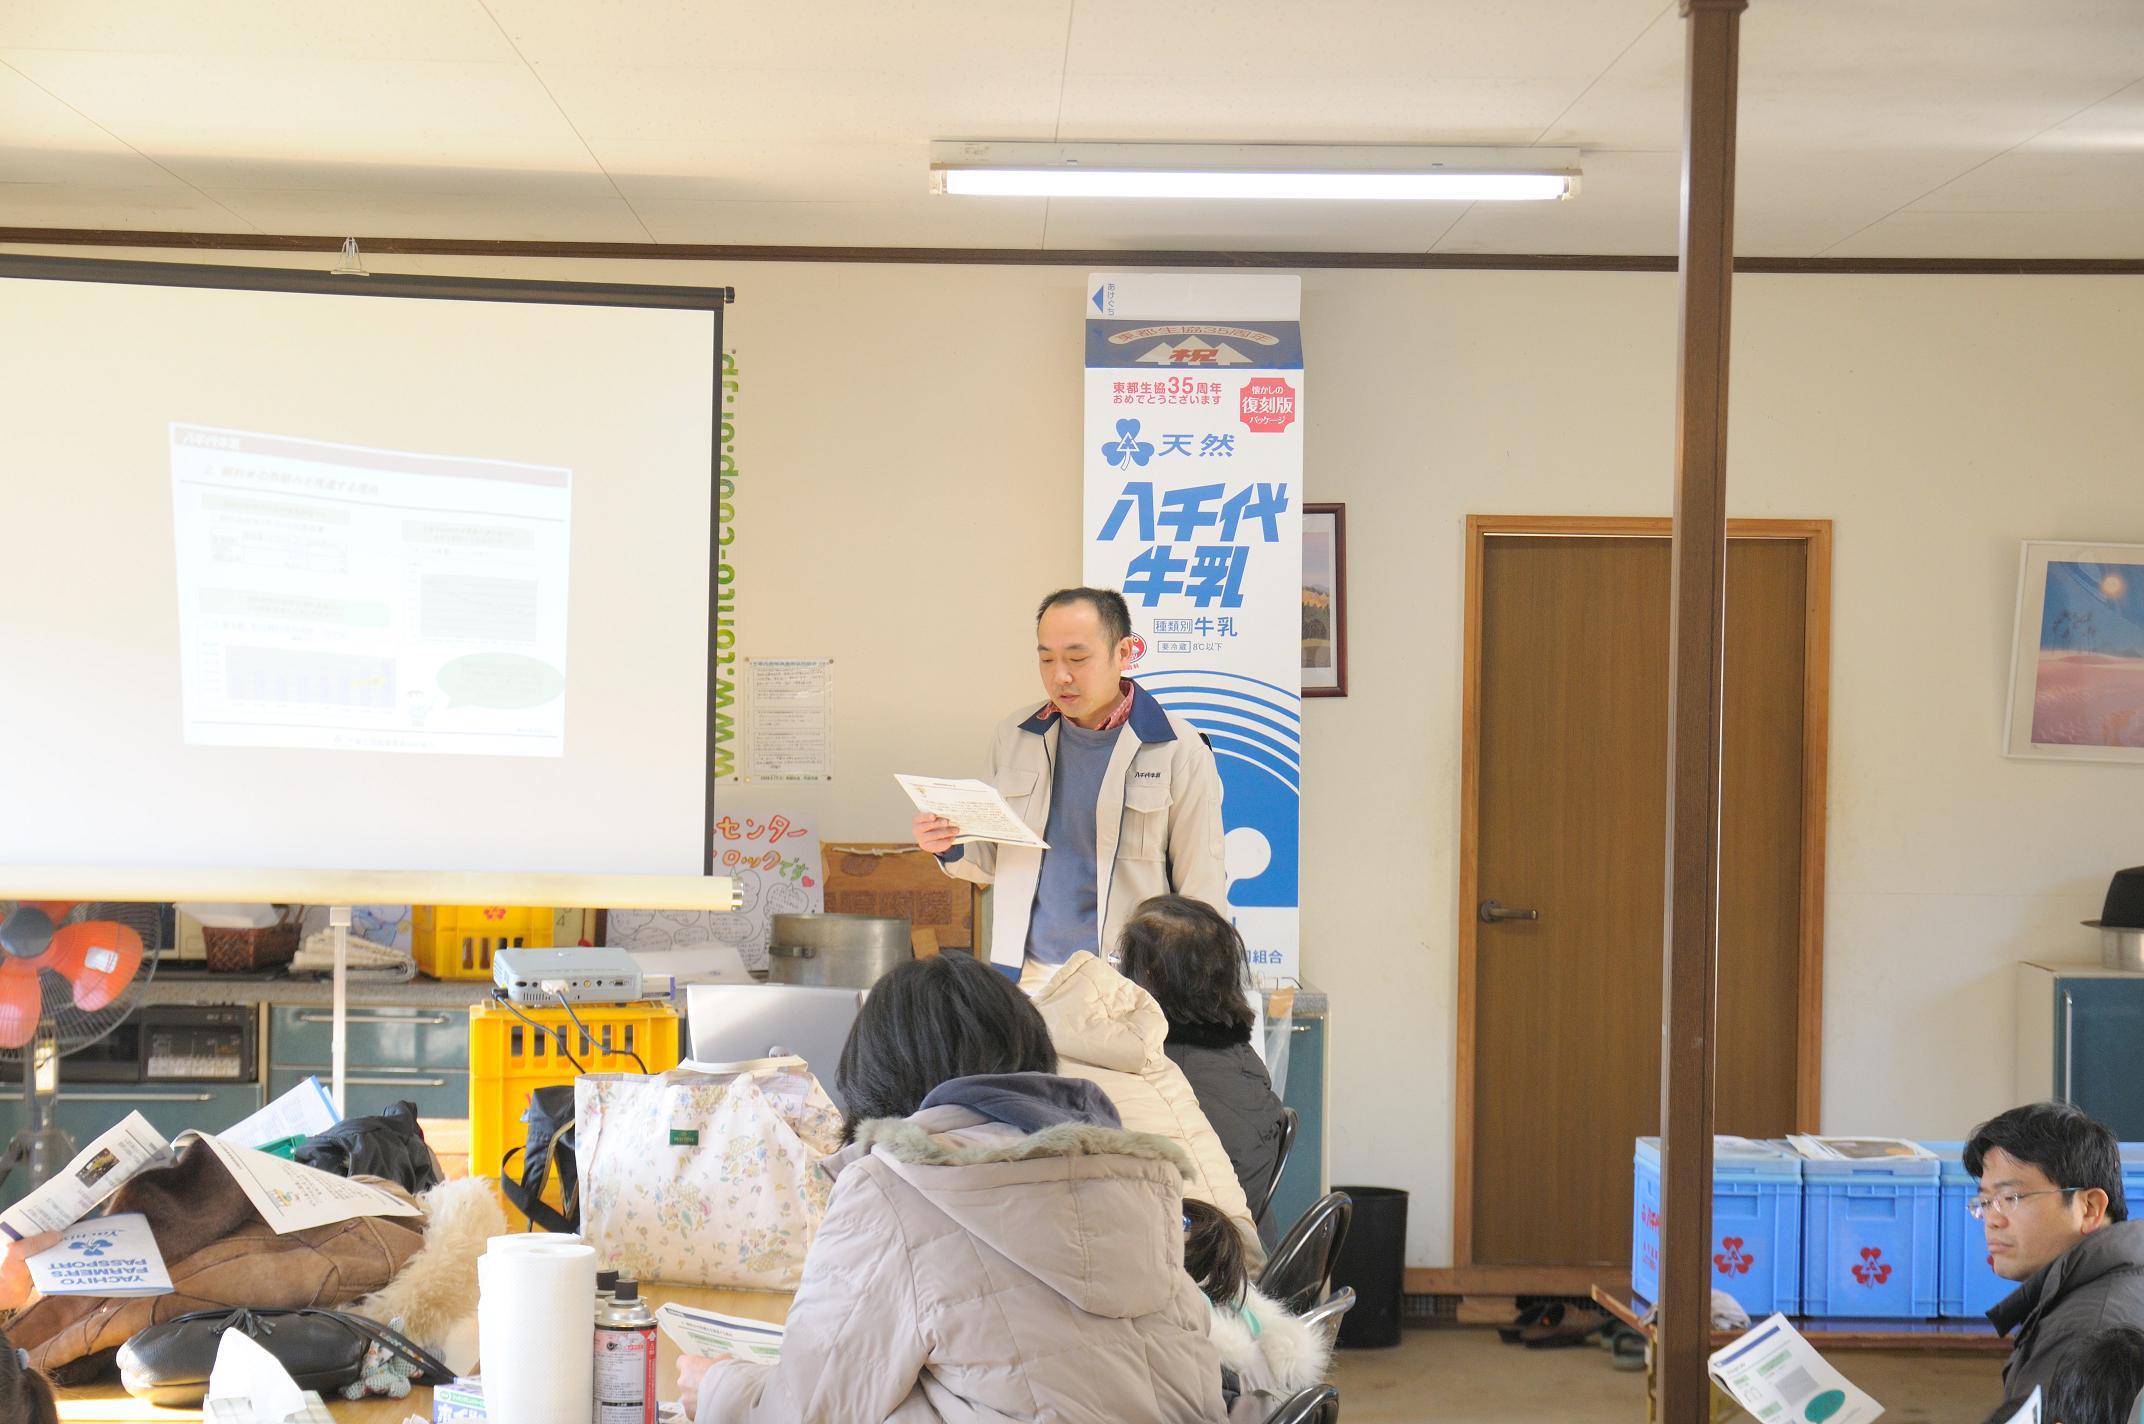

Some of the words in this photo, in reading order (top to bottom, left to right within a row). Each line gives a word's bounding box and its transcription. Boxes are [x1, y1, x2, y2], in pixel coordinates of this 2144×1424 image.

[1169, 348, 1219, 362] 祝
[1113, 376, 1222, 394] 東都生協35周年
[1251, 385, 1284, 395] 懐かしの
[1113, 394, 1221, 404] おめでとうございます
[1241, 396, 1293, 414] 復刻版
[1249, 415, 1286, 425] パッケージ
[1158, 433, 1236, 457] 天然
[1096, 481, 1289, 542] 八千代
[1122, 545, 1250, 608] 牛乳
[1155, 620, 1191, 632] 種類別
[1194, 616, 1238, 637] 牛乳
[714, 815, 808, 843] センター
[714, 850, 808, 881] ロックです
[48, 1258, 147, 1270] PASSPORT
[51, 1266, 149, 1278] FARMER'S
[60, 1275, 145, 1285] YACHIYO
